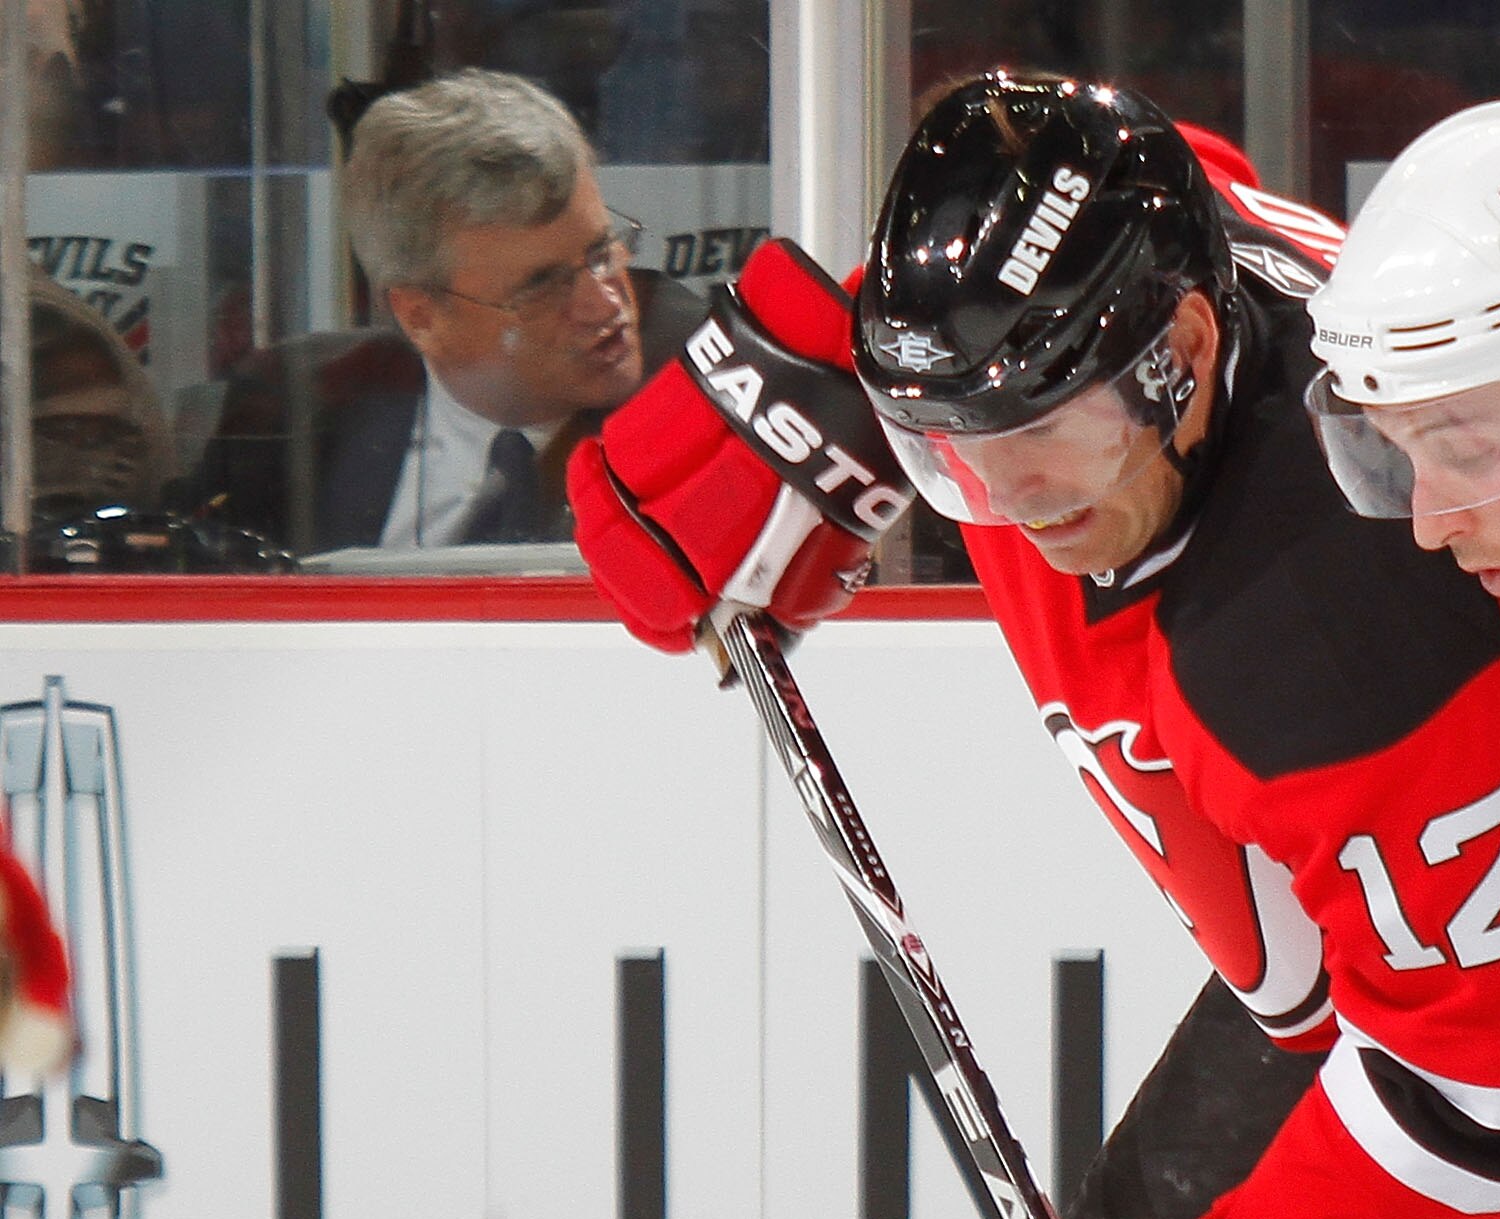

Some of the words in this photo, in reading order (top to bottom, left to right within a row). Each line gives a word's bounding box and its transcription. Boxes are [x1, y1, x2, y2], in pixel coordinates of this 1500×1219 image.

[999, 166, 1092, 297] DEVILS
[26, 236, 154, 286] VILS
[1318, 328, 1374, 349] BAUER
